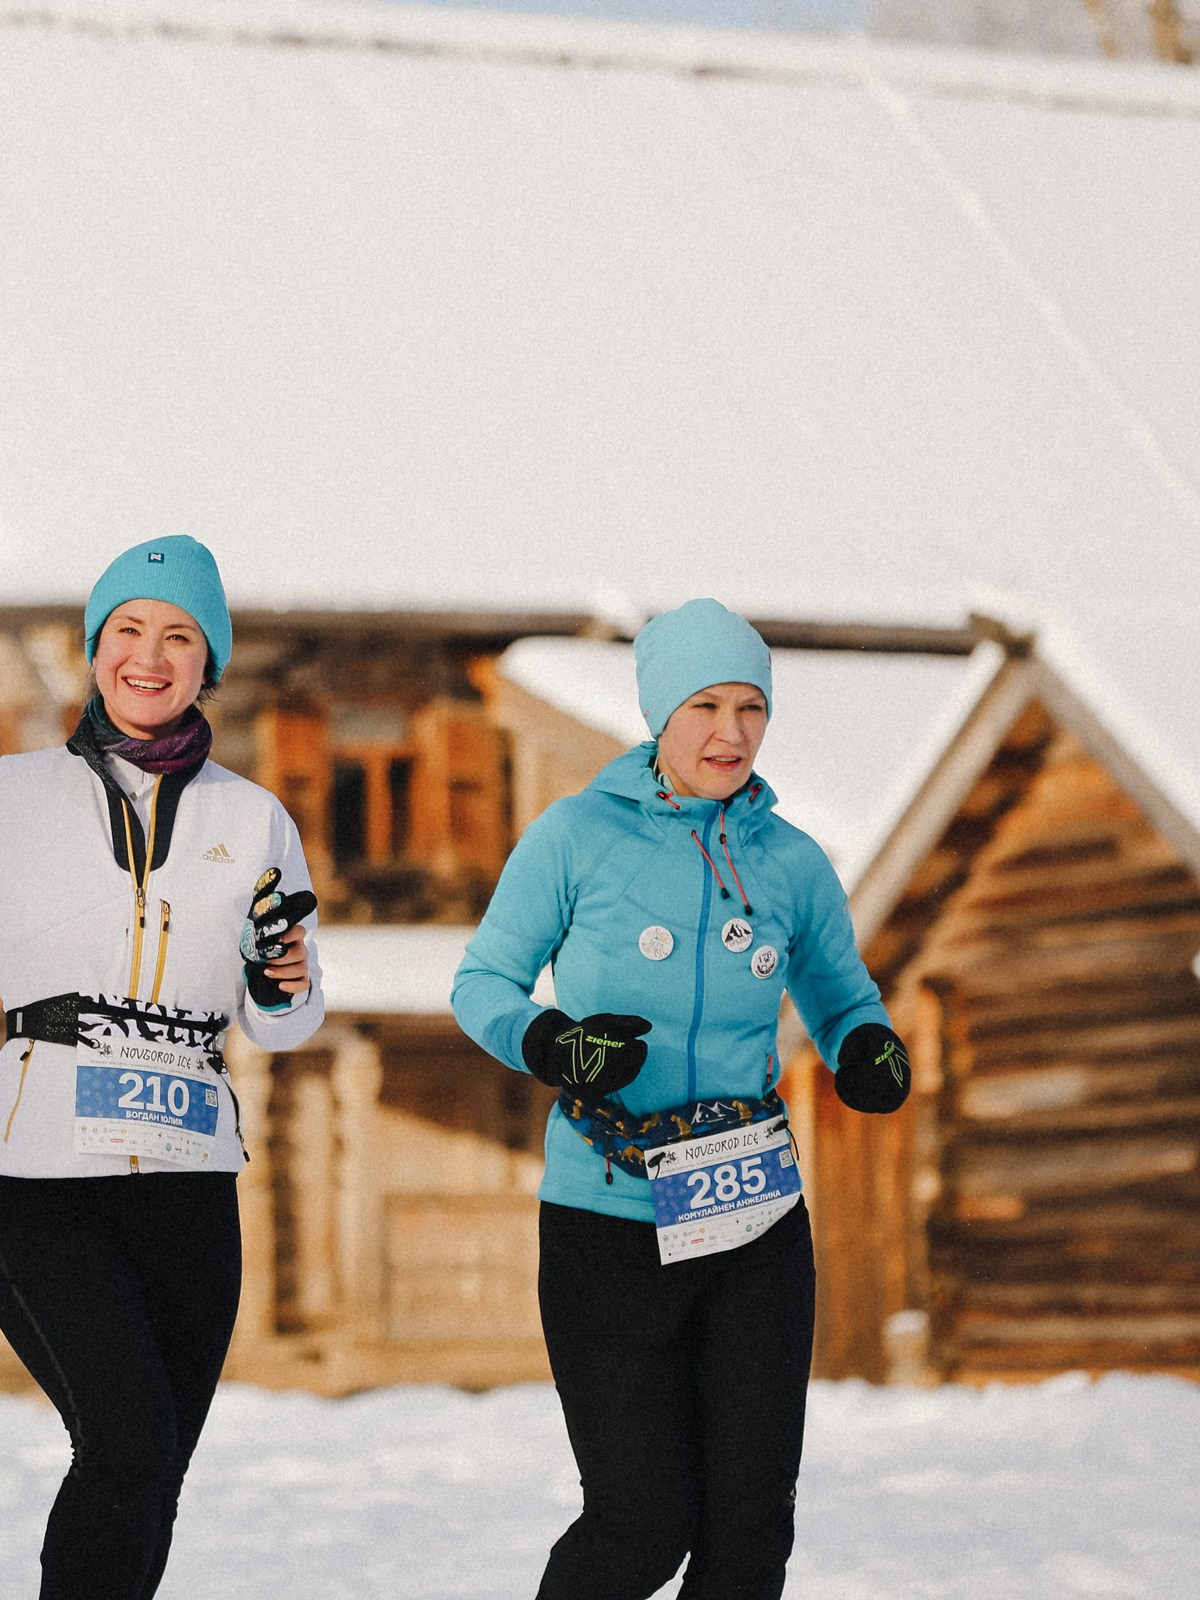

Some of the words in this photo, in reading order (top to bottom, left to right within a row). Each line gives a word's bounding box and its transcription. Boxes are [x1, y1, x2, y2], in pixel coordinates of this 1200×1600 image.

[202, 853, 236, 865] adidas
[119, 1046, 175, 1065] NOVGOROD
[177, 1055, 191, 1070] ICE
[118, 1072, 190, 1117] 210
[125, 1110, 160, 1122] БОГДАН
[160, 1114, 183, 1127] ЮЛИЯ
[685, 1137, 740, 1161] NOVGOROD
[743, 1132, 759, 1147] ICE
[687, 1156, 766, 1210] 285
[678, 1202, 736, 1223] КОМУЛАЙНЕН
[736, 1189, 782, 1209] АНЖЕЛИКА
